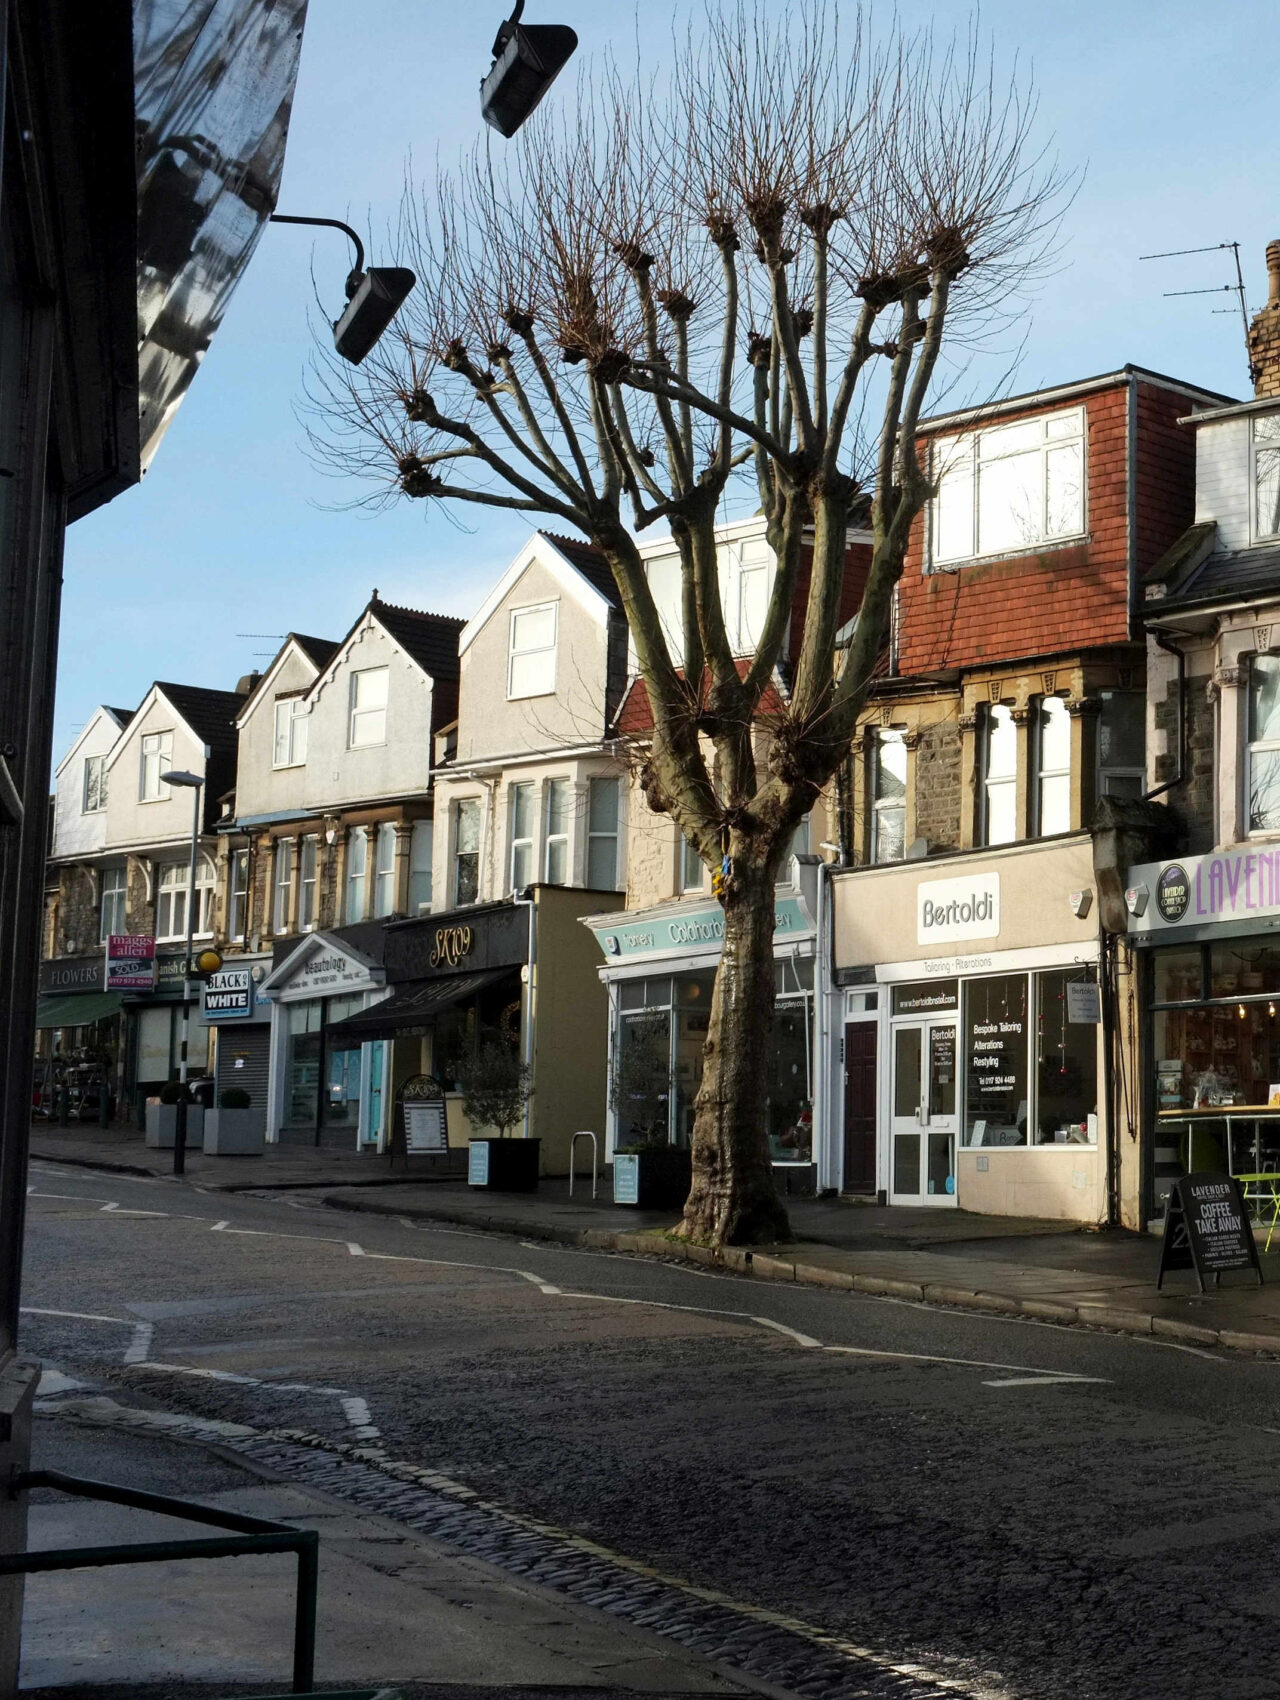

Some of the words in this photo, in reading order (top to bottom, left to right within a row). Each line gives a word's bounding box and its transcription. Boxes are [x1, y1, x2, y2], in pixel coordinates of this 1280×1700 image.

[922, 891, 993, 928] Bertoldi
[668, 918, 726, 944] Coldharbo
[113, 937, 153, 947] maggs
[429, 926, 471, 968] SK109
[117, 945, 147, 956] allen
[115, 963, 139, 974] SOLD
[160, 961, 178, 974] anish
[304, 956, 346, 974] beautology
[924, 961, 951, 974] Tailoring
[955, 957, 992, 971] Alterations
[51, 967, 98, 985] FLOWERS
[207, 974, 242, 989] BLACK
[206, 993, 247, 1008] WHITE
[931, 1028, 956, 1040] Bertoldi
[973, 1024, 998, 1035] Bespoke
[999, 1022, 1022, 1033] Tailoring
[973, 1040, 1004, 1050] Alterations
[973, 1056, 999, 1068] Restyling
[1191, 1184, 1231, 1197] LAVENDER
[1200, 1202, 1232, 1218] COFFEE
[1195, 1218, 1218, 1234] TAKE
[1219, 1216, 1242, 1232] AWAY
